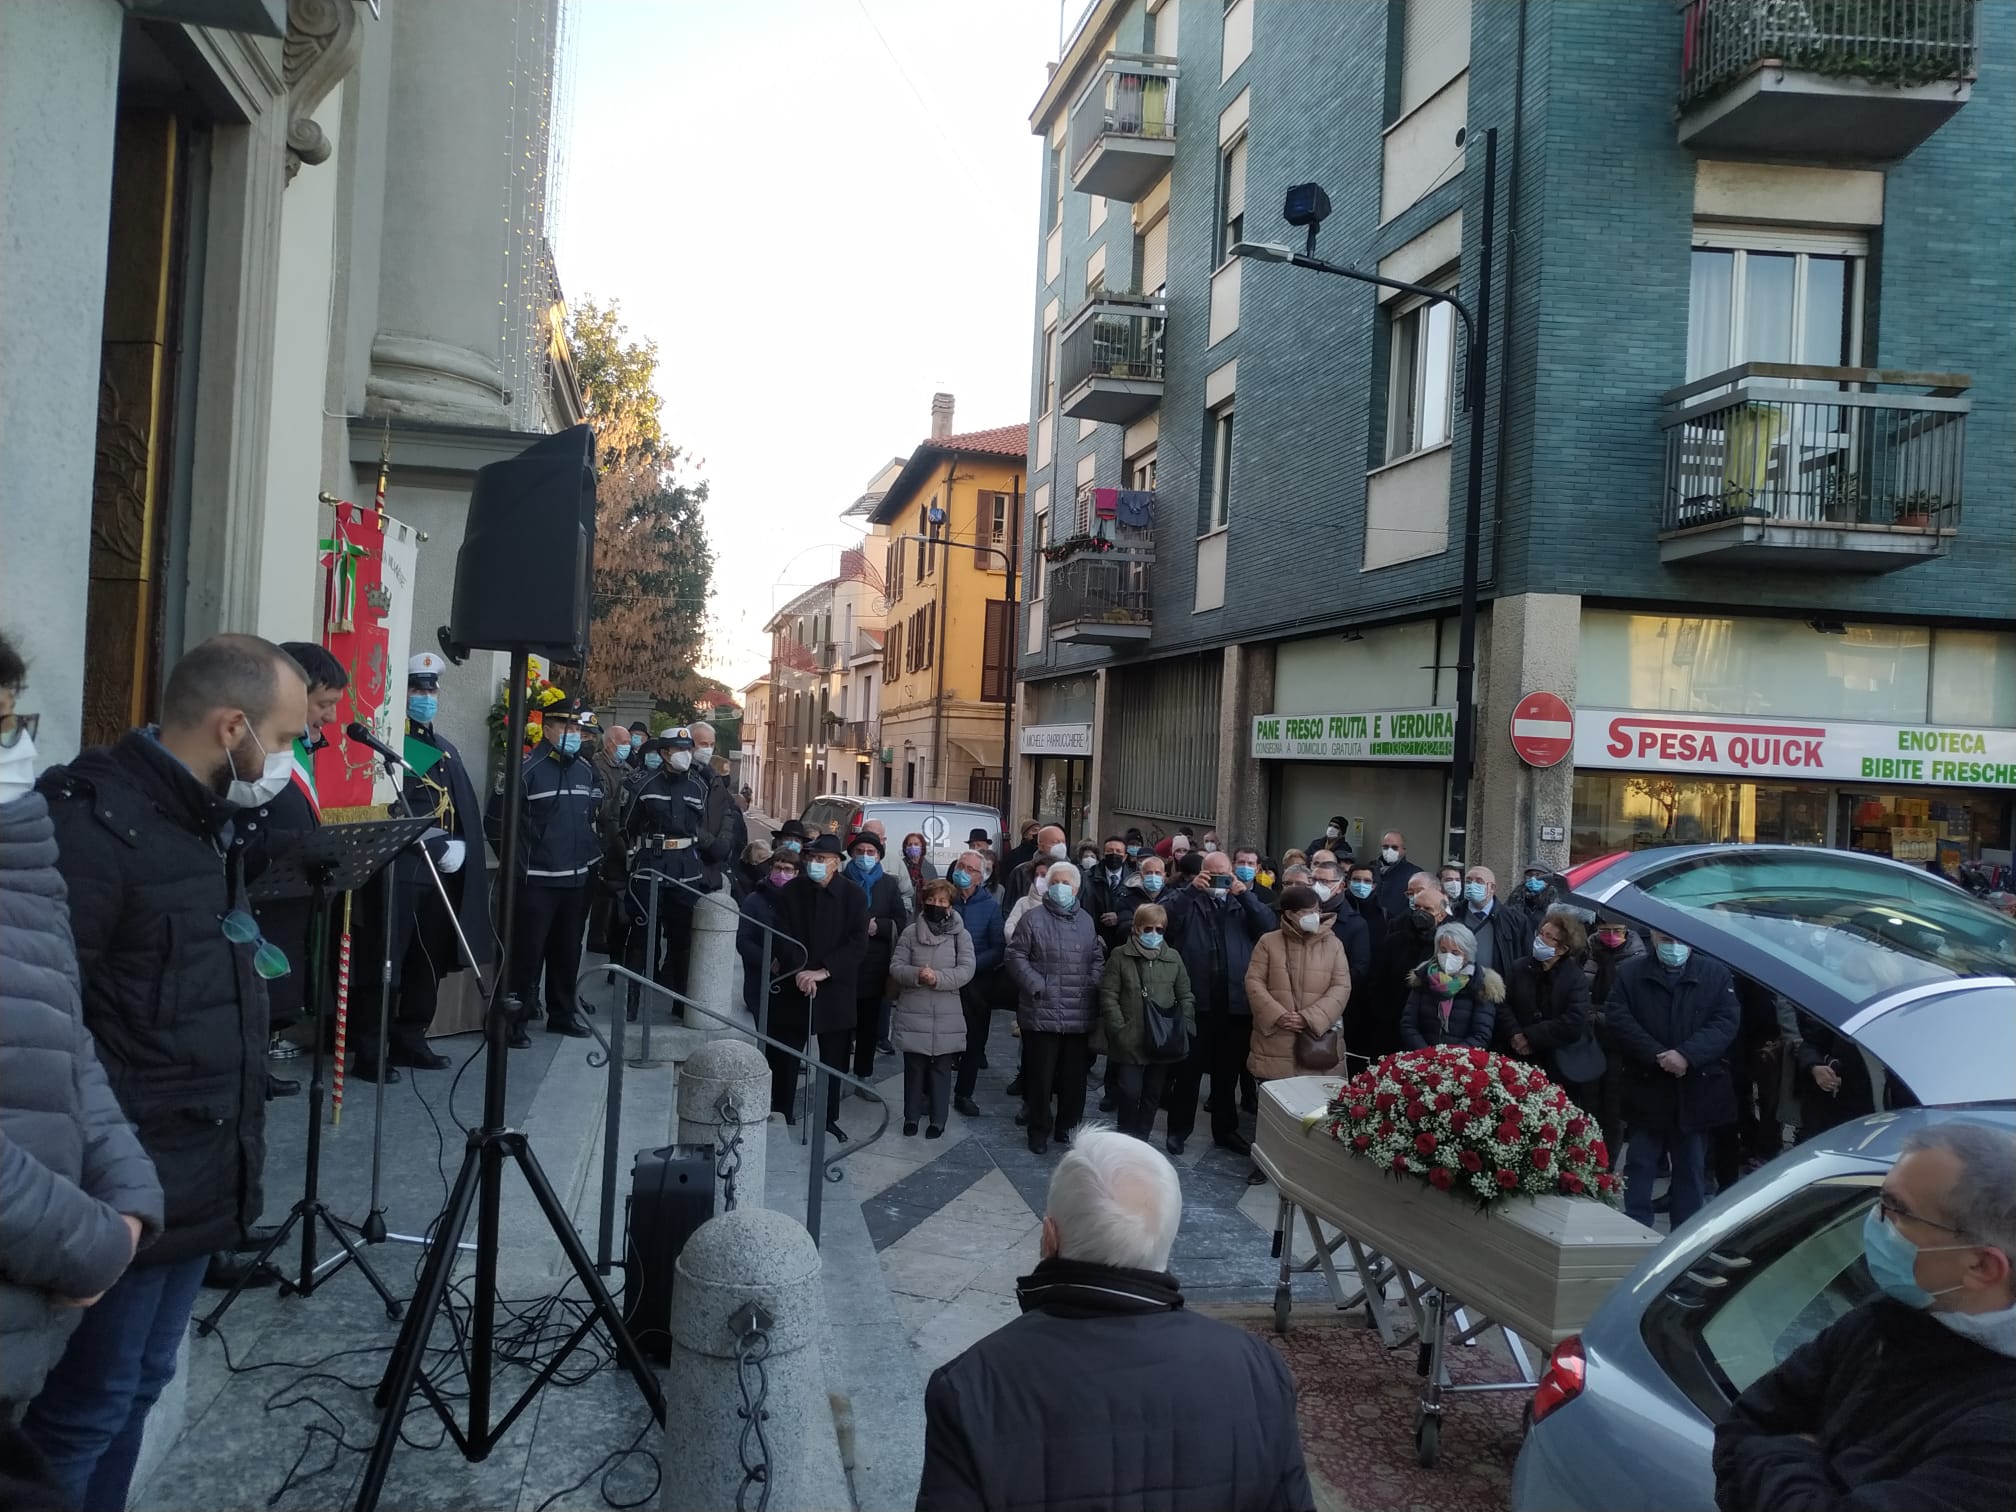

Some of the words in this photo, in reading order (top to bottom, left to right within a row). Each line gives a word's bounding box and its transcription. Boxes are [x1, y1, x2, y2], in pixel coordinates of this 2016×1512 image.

[1257, 720, 1280, 740] PANE
[1286, 718, 1324, 740] FRESCO
[1329, 716, 1367, 739] FRUTTA
[1373, 715, 1382, 738] E
[1391, 712, 1454, 738] VERDURA
[1256, 742, 1282, 754] CONSEGNA
[1287, 742, 1291, 753] A
[1297, 742, 1327, 755] DOMICILIO
[1332, 742, 1362, 756] GRATUITA
[1607, 718, 1719, 763] SPESA
[1728, 736, 1825, 769] QUICK
[1898, 730, 1987, 755] ENOTECA
[1861, 757, 1924, 780] BIBITE
[1932, 760, 2016, 784] FRESCHE
